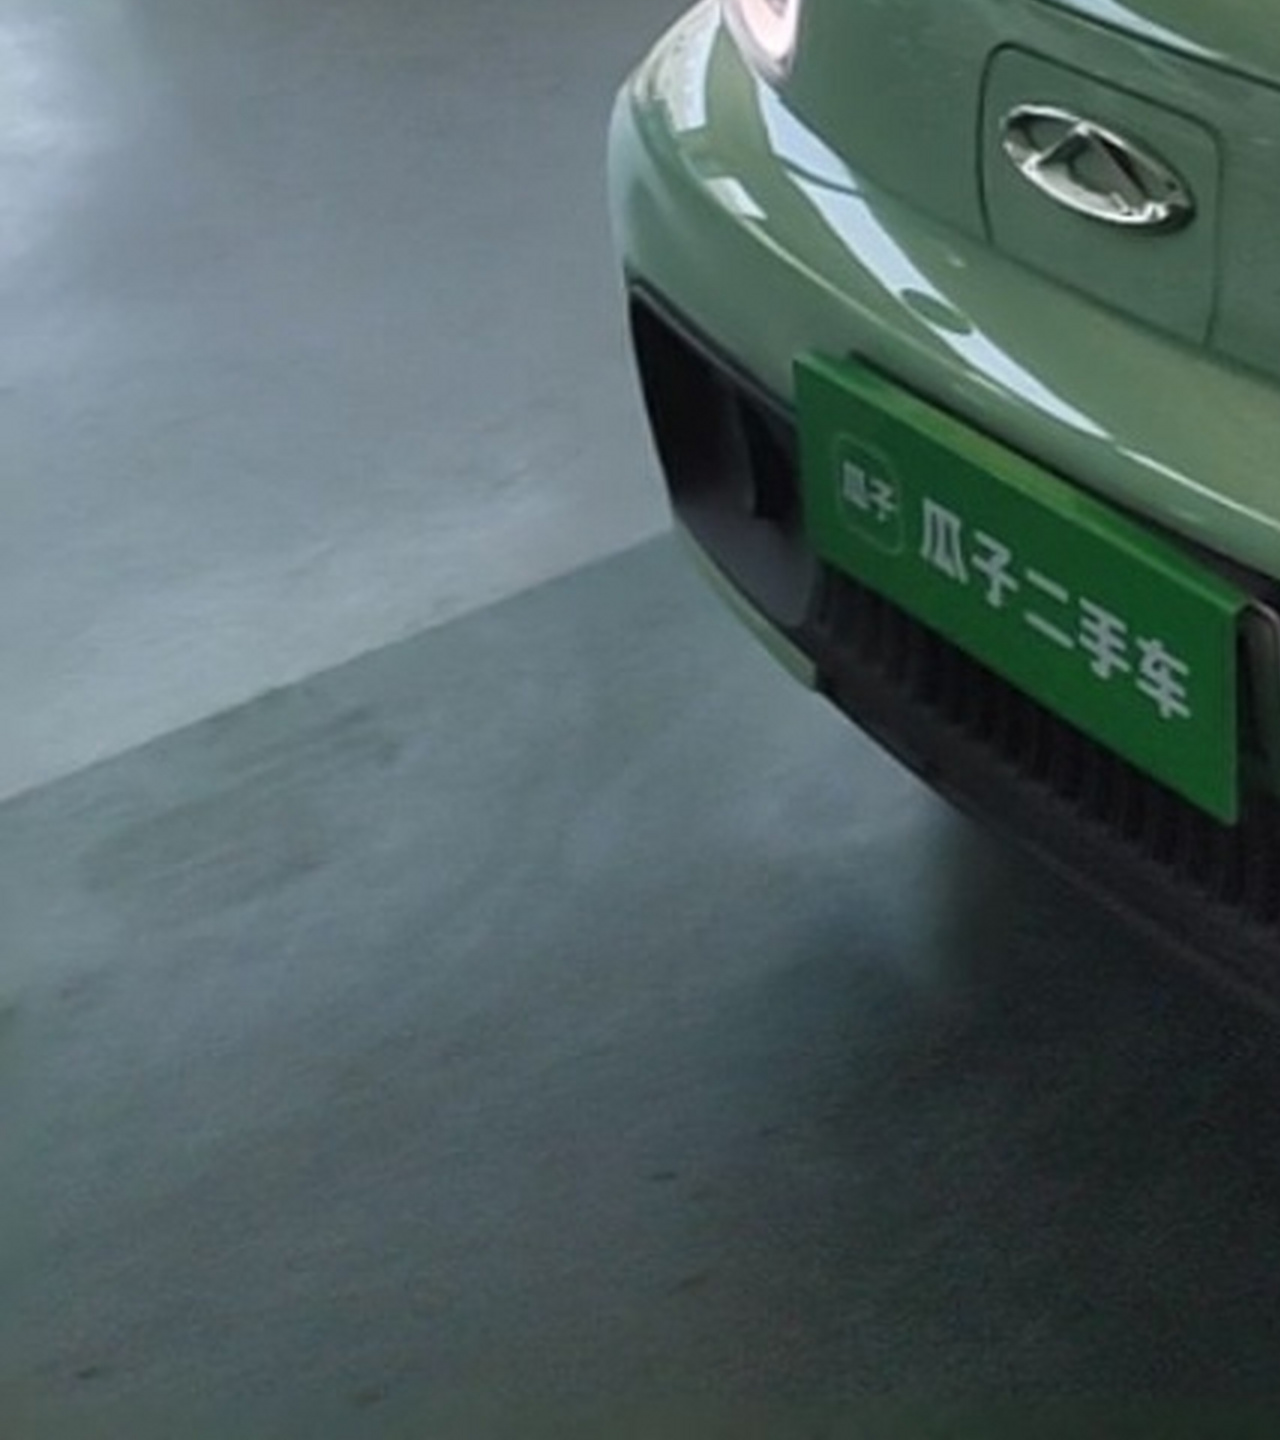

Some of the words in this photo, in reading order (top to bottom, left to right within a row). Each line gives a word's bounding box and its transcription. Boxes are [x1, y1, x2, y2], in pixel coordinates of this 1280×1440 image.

[920, 497, 1190, 719] 瓜子二手车
